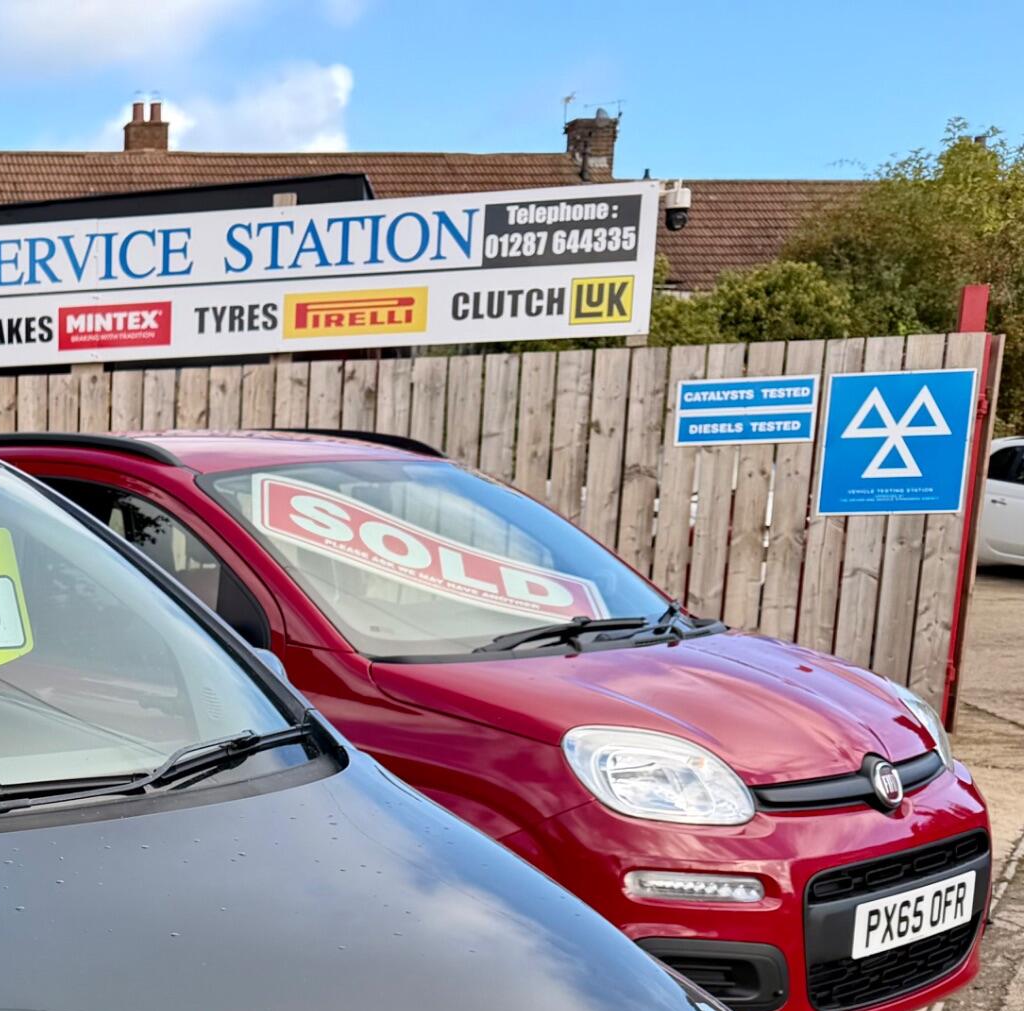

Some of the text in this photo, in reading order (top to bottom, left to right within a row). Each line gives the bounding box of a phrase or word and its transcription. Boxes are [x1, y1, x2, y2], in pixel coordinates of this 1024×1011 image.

[223, 208, 480, 274] STATION
[484, 226, 637, 260] 01287 644335
[194, 303, 279, 334] TYRES
[294, 296, 416, 330] PIRELLI
[451, 287, 566, 321] CLUTCH
[66, 310, 159, 334] MINTEX
[683, 386, 811, 403] CATALYSTS TESTED
[688, 420, 802, 435] DIESELS TESTED
[288, 494, 574, 608] SOLD
[865, 896, 924, 947] PX65
